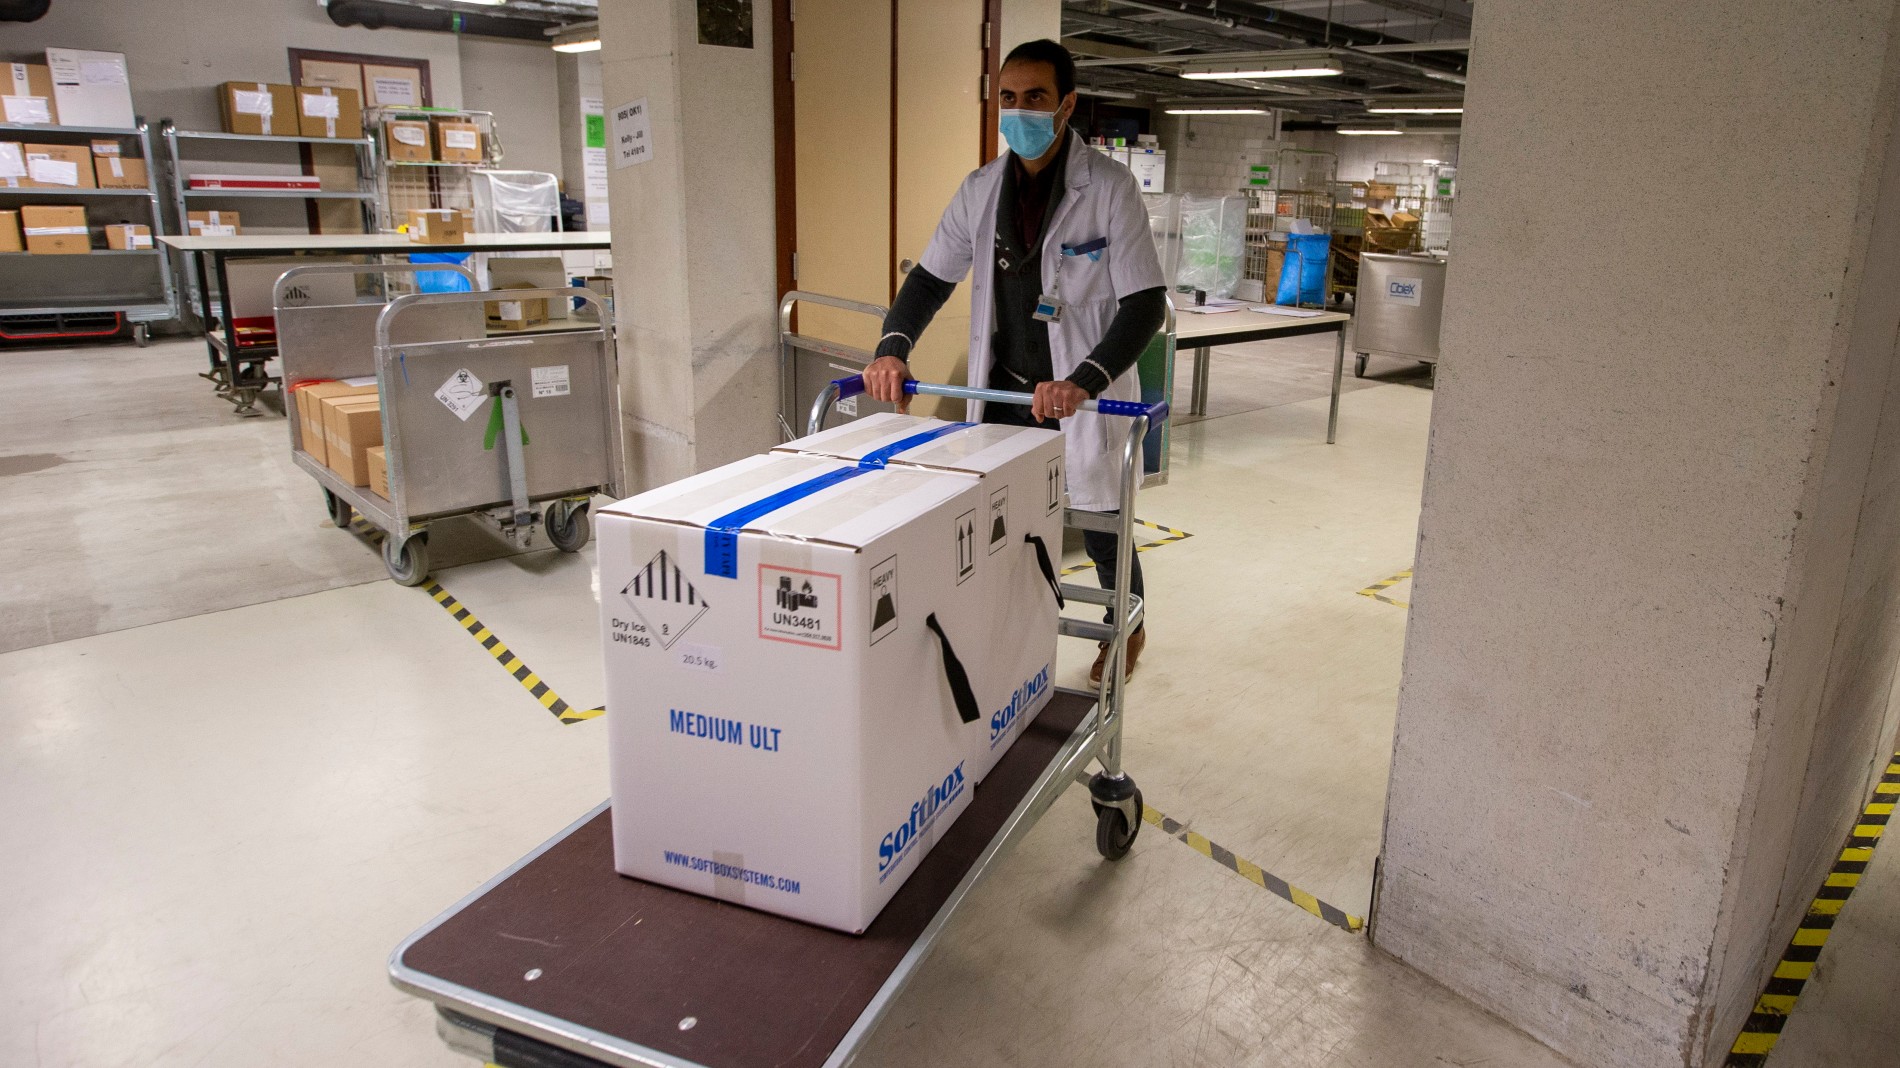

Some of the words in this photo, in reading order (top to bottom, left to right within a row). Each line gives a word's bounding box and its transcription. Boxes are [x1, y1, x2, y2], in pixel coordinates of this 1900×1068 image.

[991, 497, 1006, 511] HEAVY
[872, 568, 894, 590] HEAVY
[611, 618, 629, 632] Dry
[631, 622, 647, 633] Ice
[773, 612, 821, 631] UN3481
[612, 632, 651, 648] UN1845
[683, 654, 703, 666] 20.5
[990, 662, 1049, 741] Softbox
[669, 709, 743, 745] MEDIUM
[749, 724, 782, 752] ULT
[878, 759, 965, 872] Softbox
[664, 850, 801, 894] WWW.SOFTBOXSYSTEMS.COM
